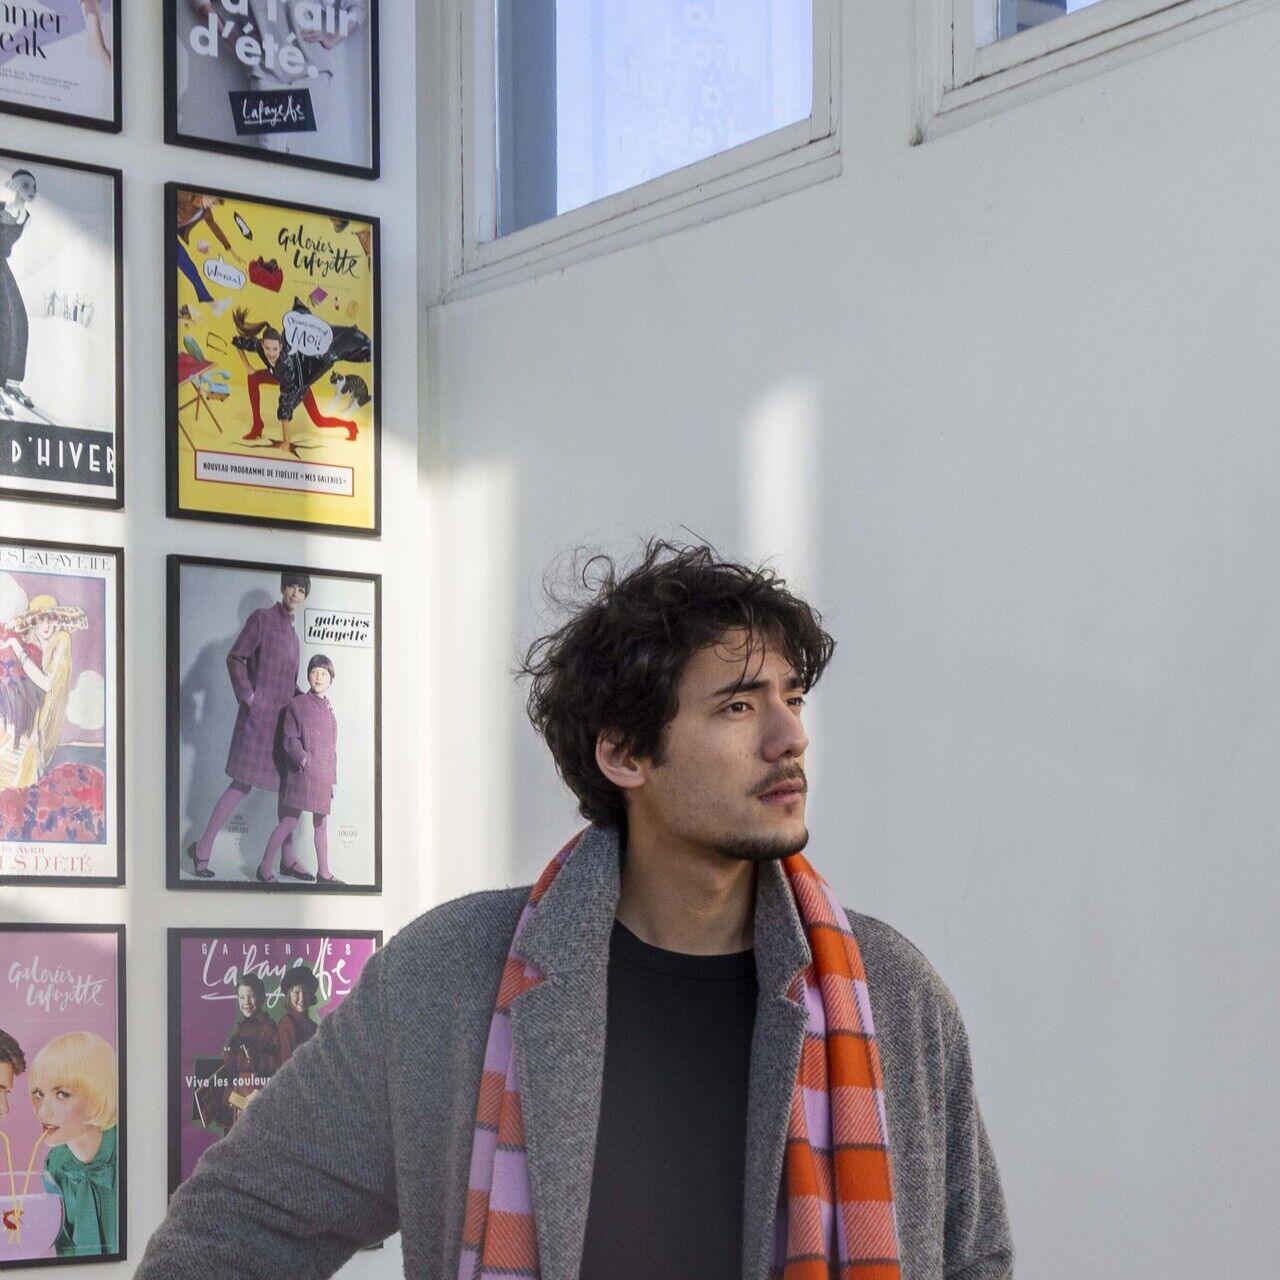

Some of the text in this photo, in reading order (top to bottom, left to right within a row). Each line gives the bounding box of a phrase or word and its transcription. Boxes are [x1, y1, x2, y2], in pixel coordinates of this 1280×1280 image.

[189, 12, 320, 79] d'été.
[277, 224, 334, 254] Galeries
[292, 249, 362, 280] Lafayette
[11, 436, 115, 475] D'HIVER
[202, 461, 343, 485] NOUVEAU PROGRAMME DE MES GALERIES
[21, 548, 112, 572] LAFAYETTE
[308, 626, 368, 642] lafayette
[314, 614, 370, 628] galeries
[201, 943, 352, 957] GALERIES
[7, 955, 77, 991] Galeries
[25, 975, 111, 1012] Lafayette
[185, 1073, 272, 1089] Vive les couleur
